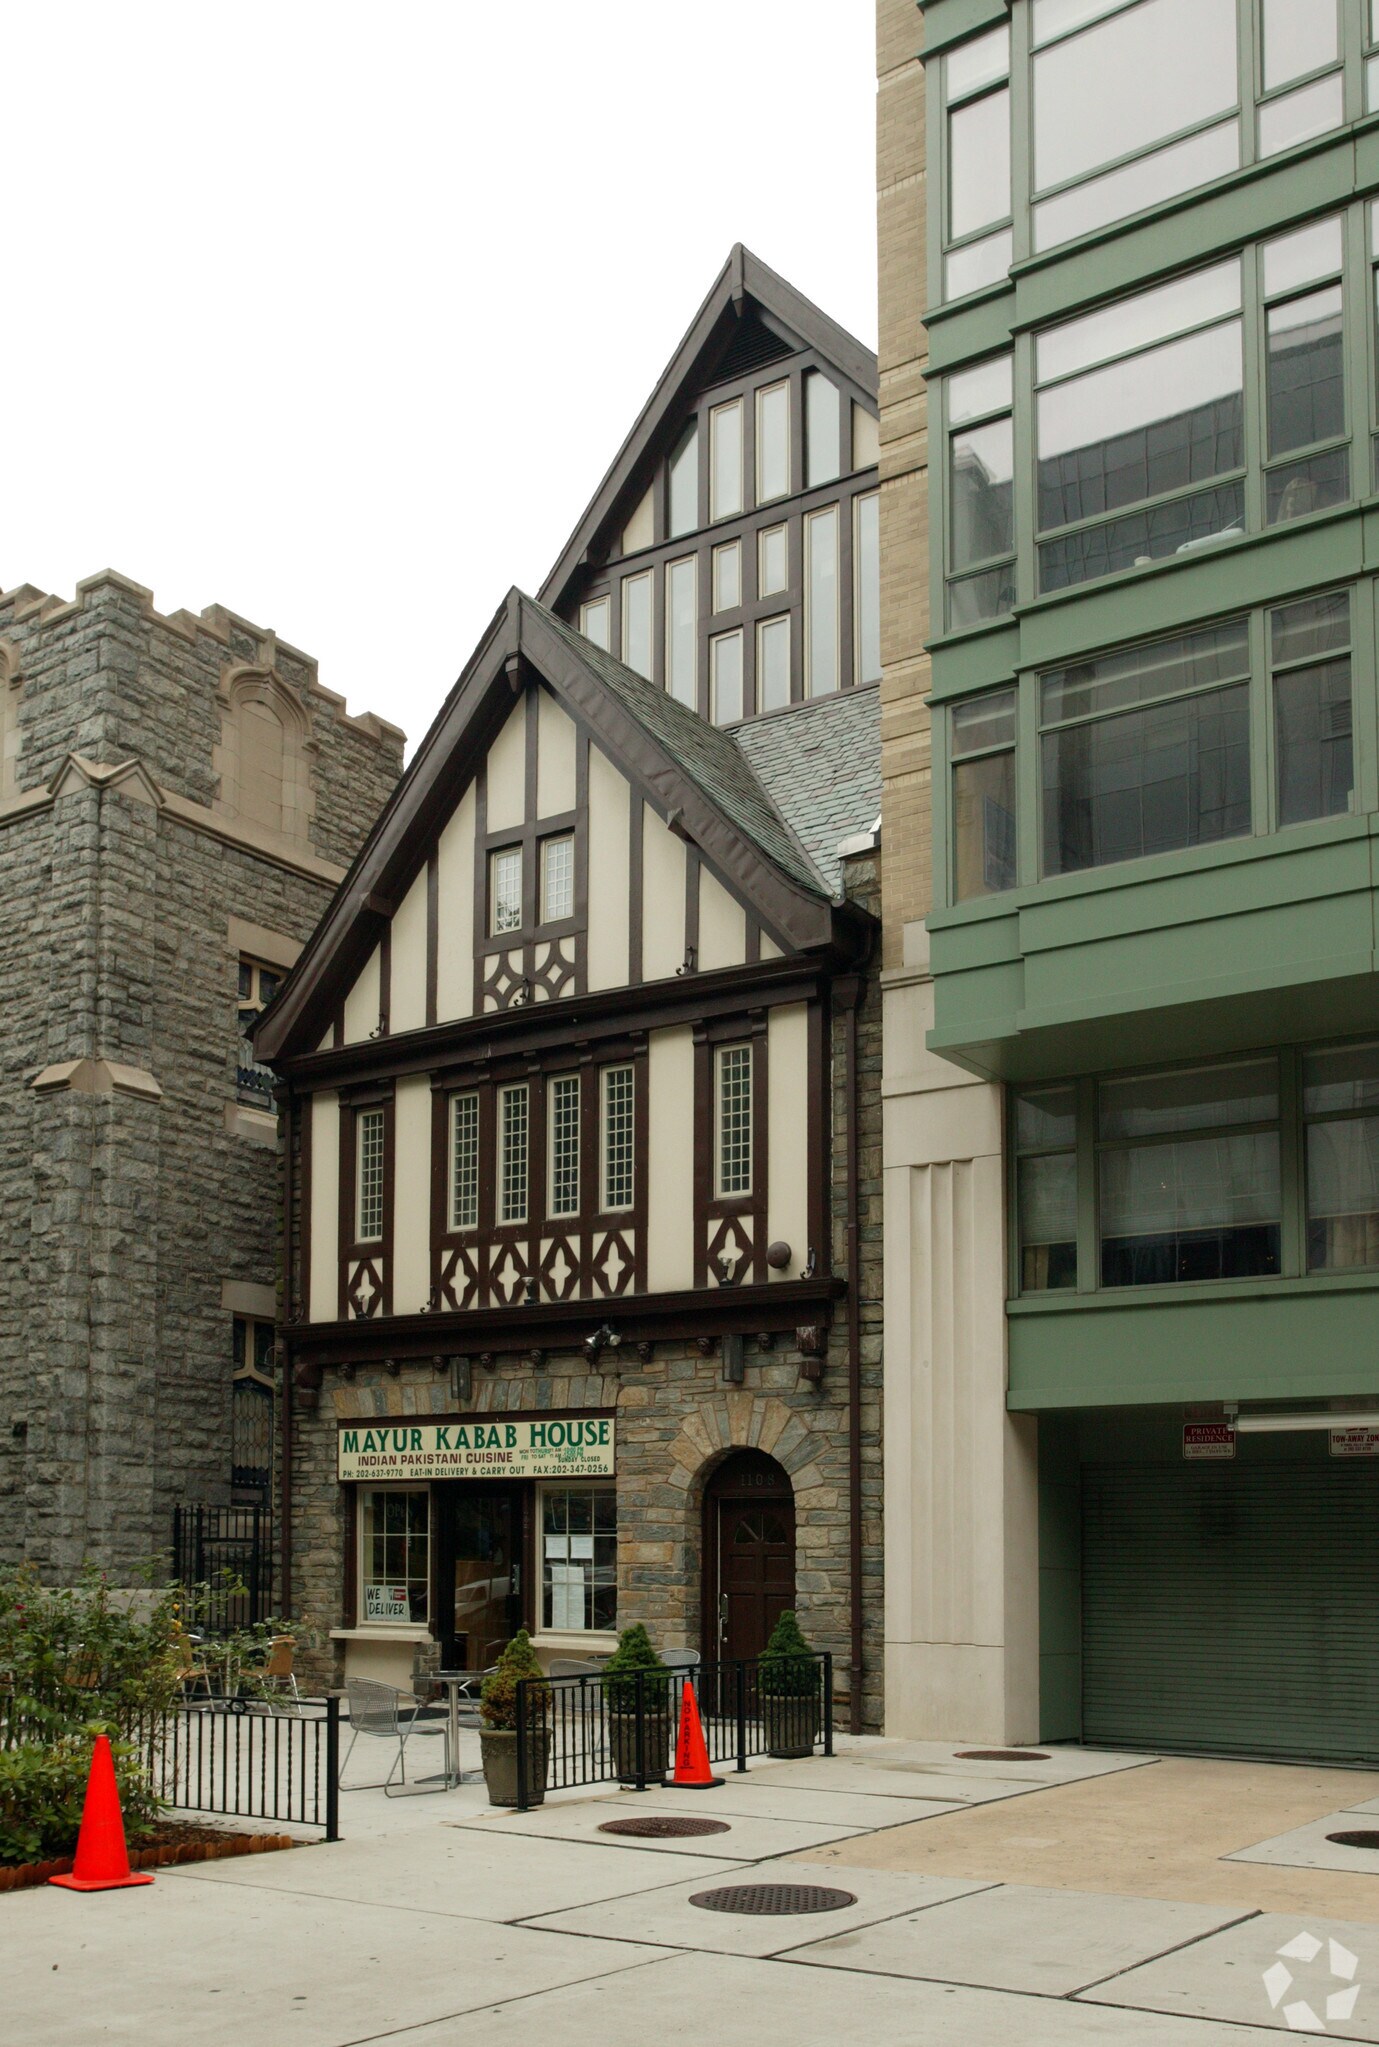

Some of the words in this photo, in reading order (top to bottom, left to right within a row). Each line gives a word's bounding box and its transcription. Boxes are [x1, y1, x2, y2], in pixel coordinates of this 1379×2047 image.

[342, 1428, 424, 1453] MAYUR
[435, 1424, 518, 1450] KABAB
[529, 1420, 611, 1447] HOUSE
[1191, 1427, 1228, 1435] PRIVATE
[1186, 1434, 1233, 1442] RESIDENCE
[1332, 1434, 1365, 1443] TOW-AWAY
[358, 1455, 397, 1466] INDIAN
[400, 1453, 461, 1465] PAKISTANI
[465, 1452, 513, 1463] CUISINE
[342, 1470, 354, 1478] PH:
[356, 1468, 404, 1478] 202-637-9770
[410, 1468, 433, 1477] EAT-IN
[435, 1467, 469, 1476] DELIVERY
[471, 1467, 477, 1475] &
[480, 1466, 506, 1475] CARRY
[509, 1466, 525, 1474] OUT
[741, 1473, 775, 1486] 1108
[367, 1588, 381, 1600] WE
[683, 1701, 691, 1714] NO
[683, 1717, 691, 1766] PARKING
